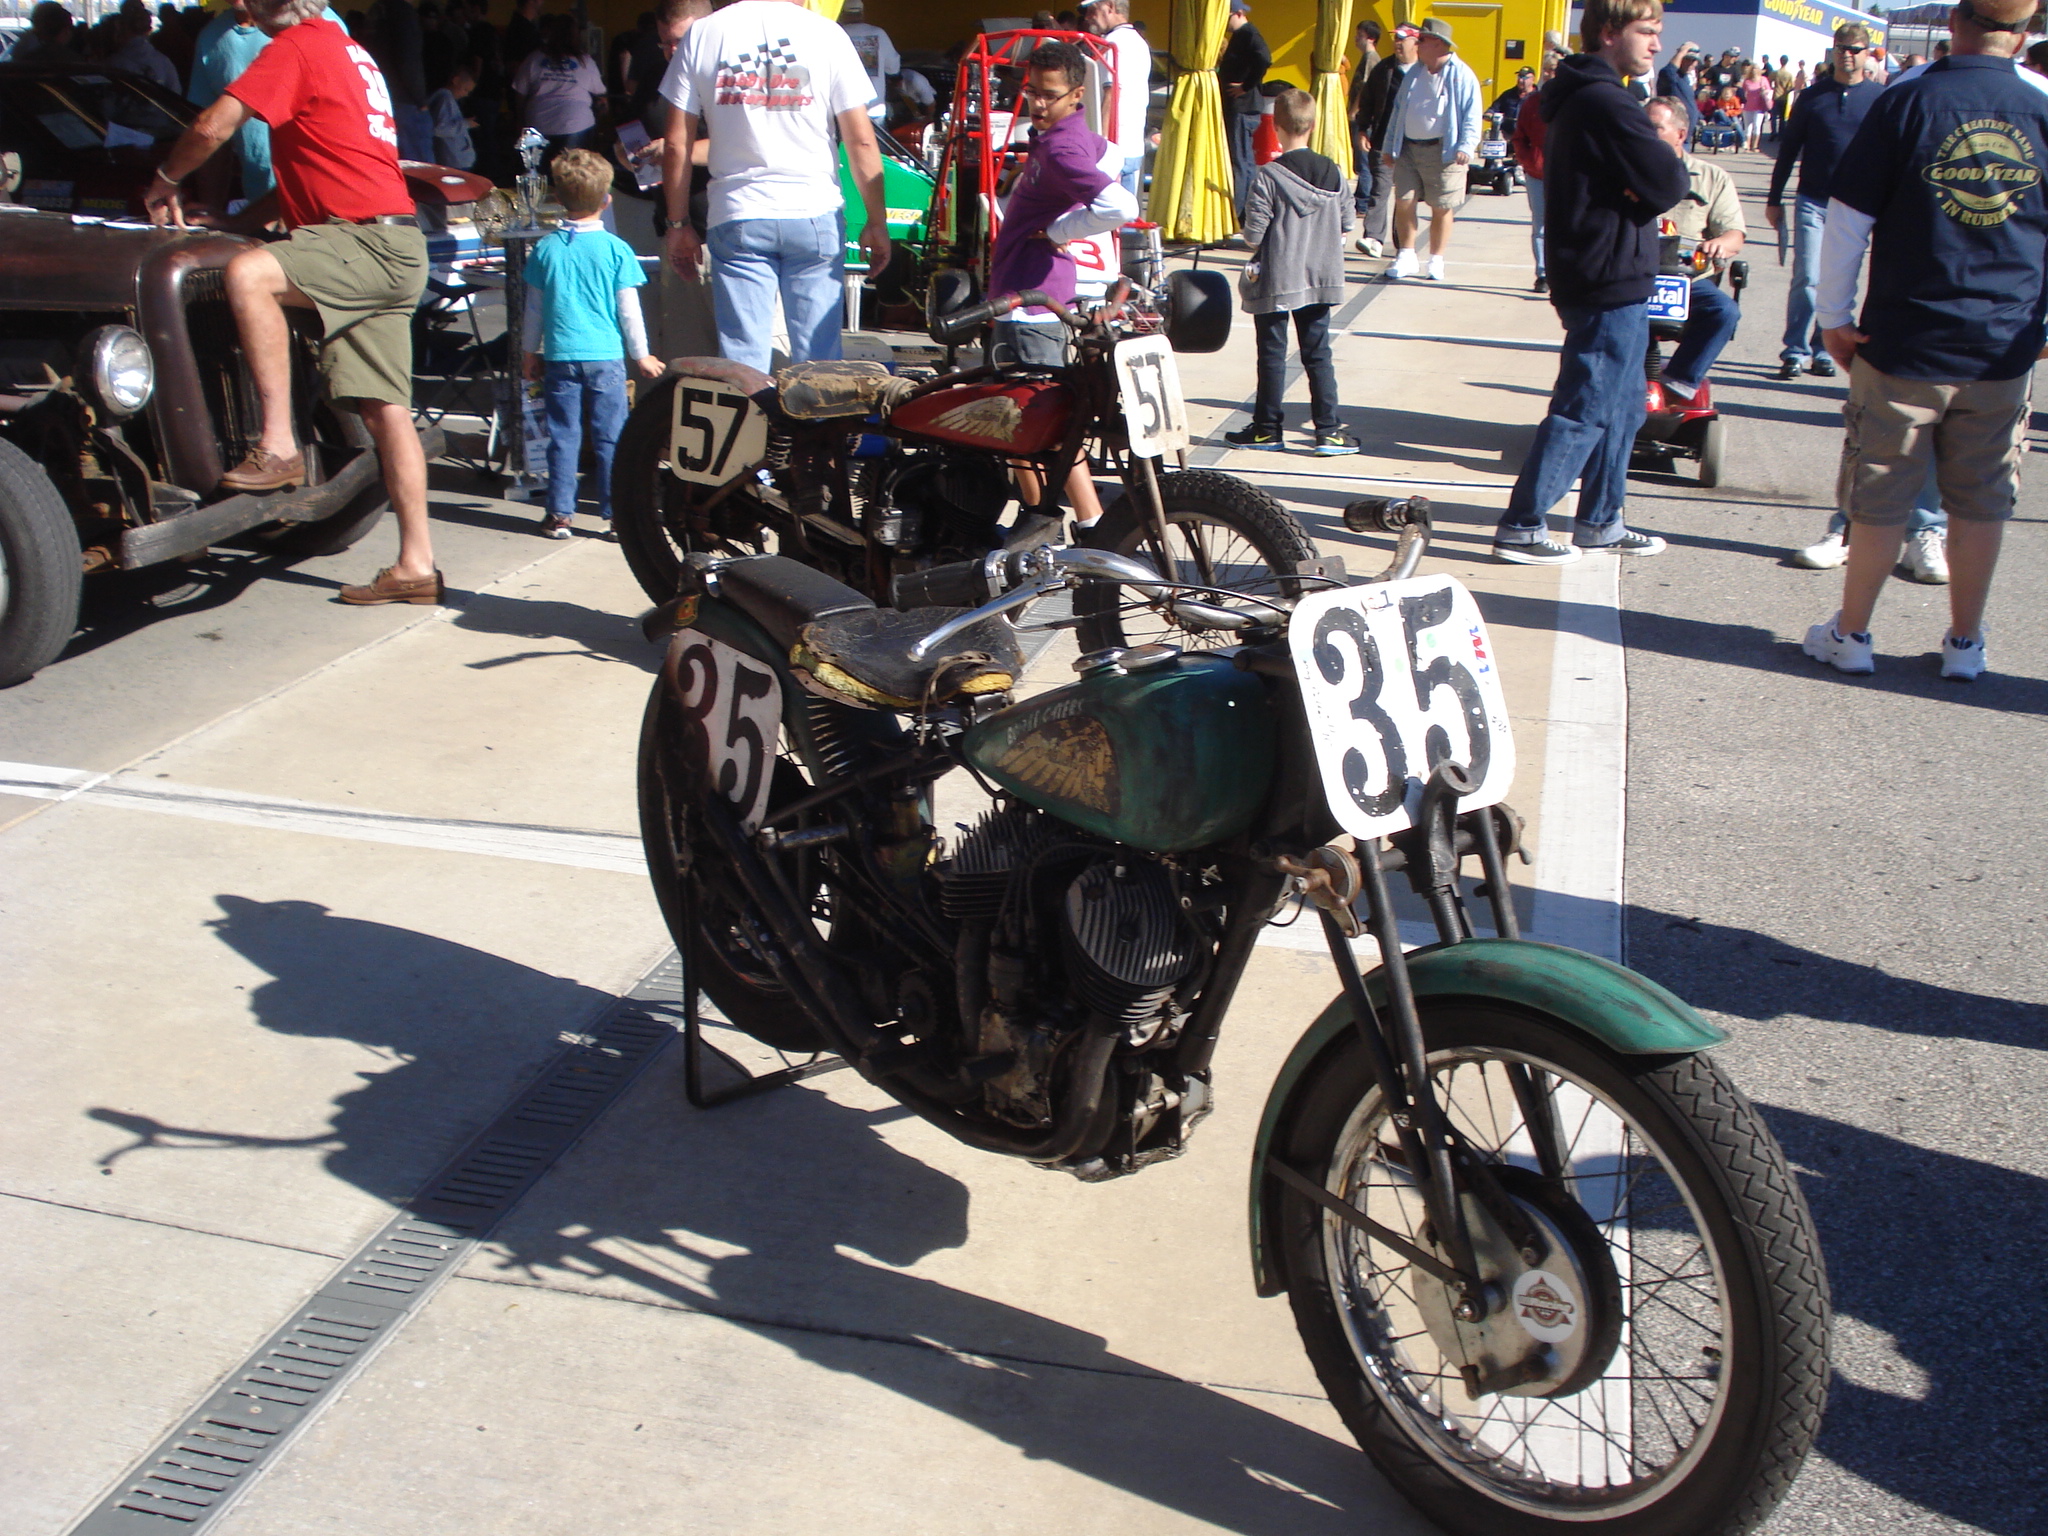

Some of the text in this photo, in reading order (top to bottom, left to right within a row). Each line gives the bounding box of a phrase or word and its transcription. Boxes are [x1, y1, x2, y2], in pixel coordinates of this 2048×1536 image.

[1930, 162, 2038, 183] GOODYEAR
[2011, 128, 2035, 160] NAME
[1940, 199, 1961, 217] IN
[678, 387, 749, 477] 57
[675, 643, 772, 823] 35
[1312, 587, 1491, 818] 35
